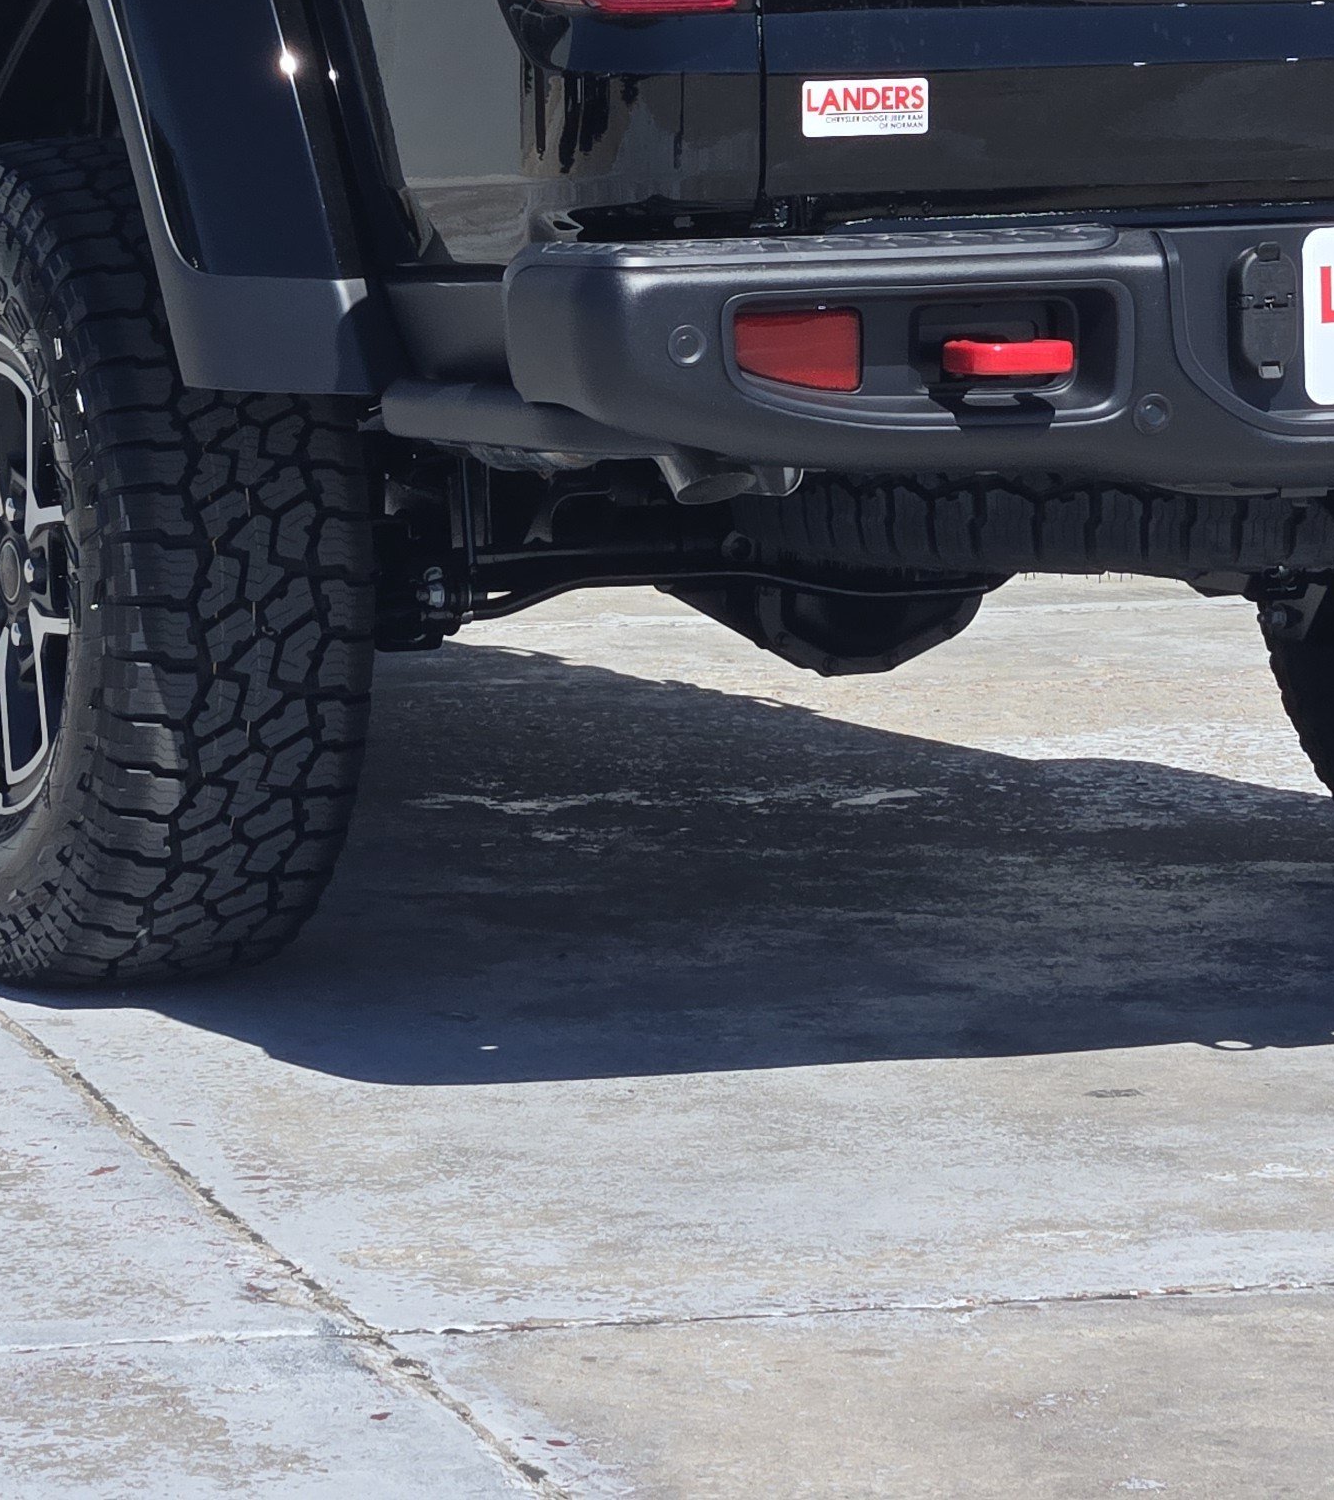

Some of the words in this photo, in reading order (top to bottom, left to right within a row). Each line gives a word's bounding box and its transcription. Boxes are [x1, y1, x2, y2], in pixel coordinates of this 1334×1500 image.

[806, 85, 925, 115] LANDERS
[825, 116, 860, 124] CHRYSLER
[861, 115, 888, 123] DODGE
[890, 114, 906, 122] JEEP
